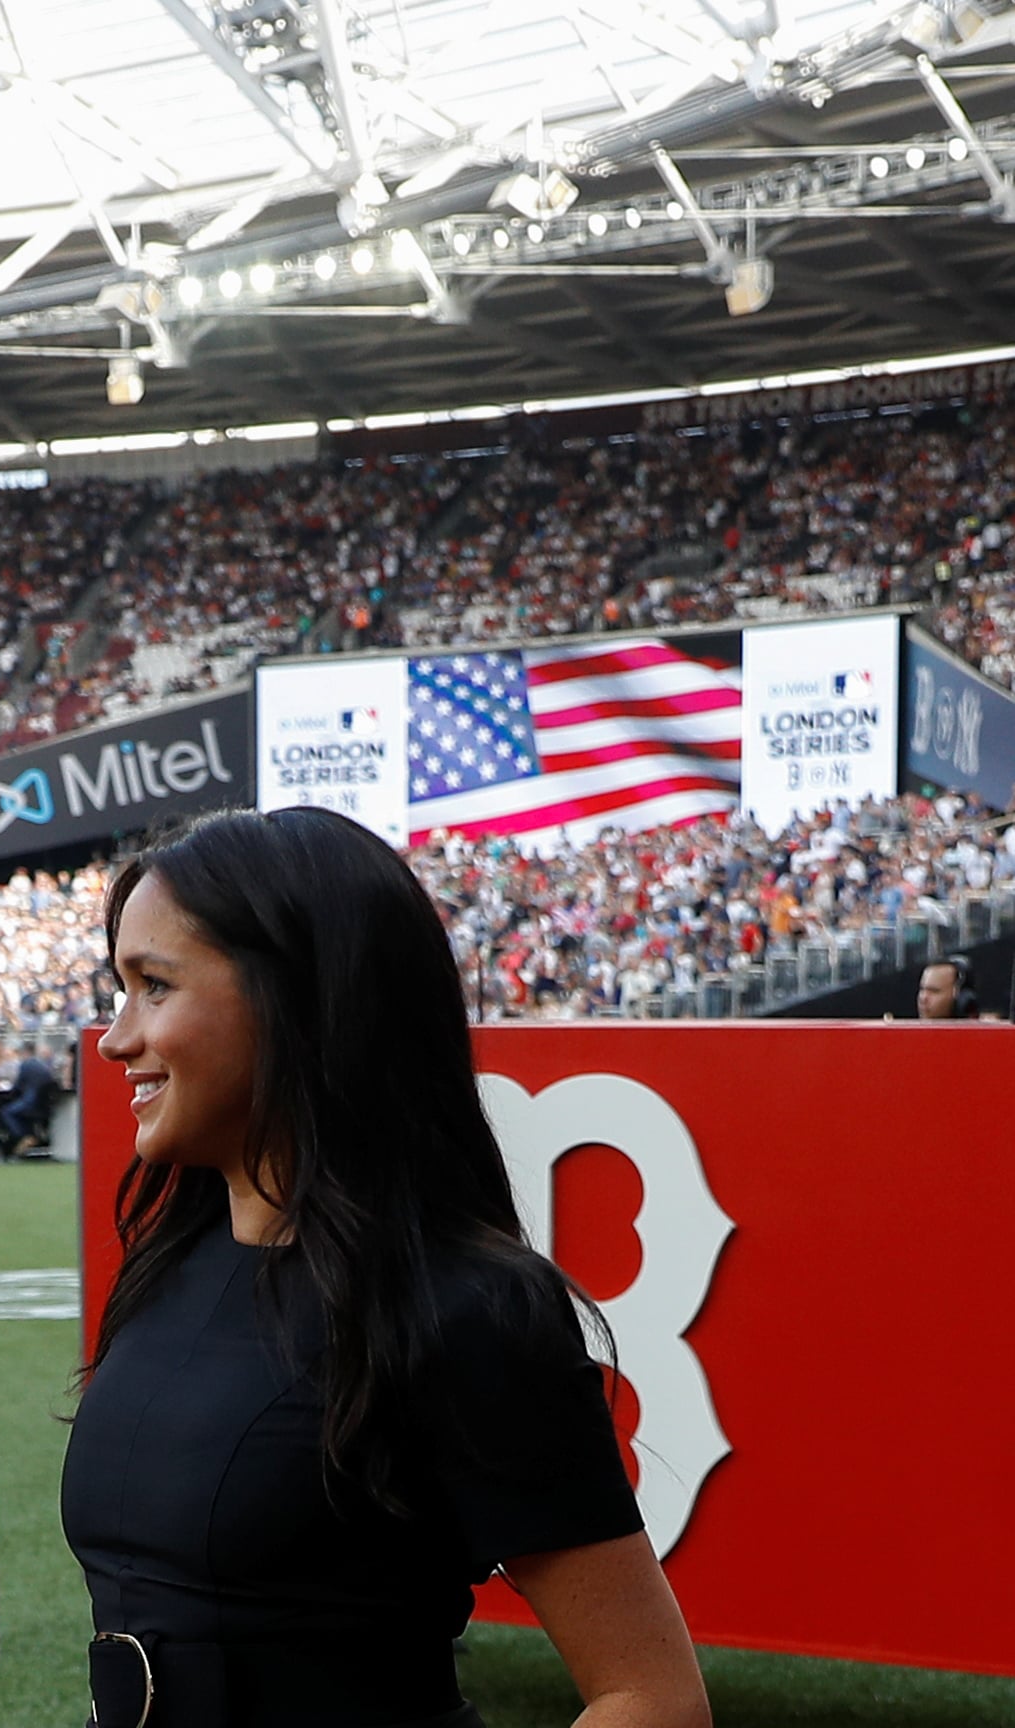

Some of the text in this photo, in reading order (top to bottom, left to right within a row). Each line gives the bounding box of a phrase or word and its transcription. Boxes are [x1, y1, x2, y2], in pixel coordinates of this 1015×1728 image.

[761, 706, 878, 735] LONDON
[271, 742, 385, 765] LONDON
[769, 731, 871, 759] SERIES
[59, 718, 232, 817] Mitel
[280, 764, 379, 788] SERIES
